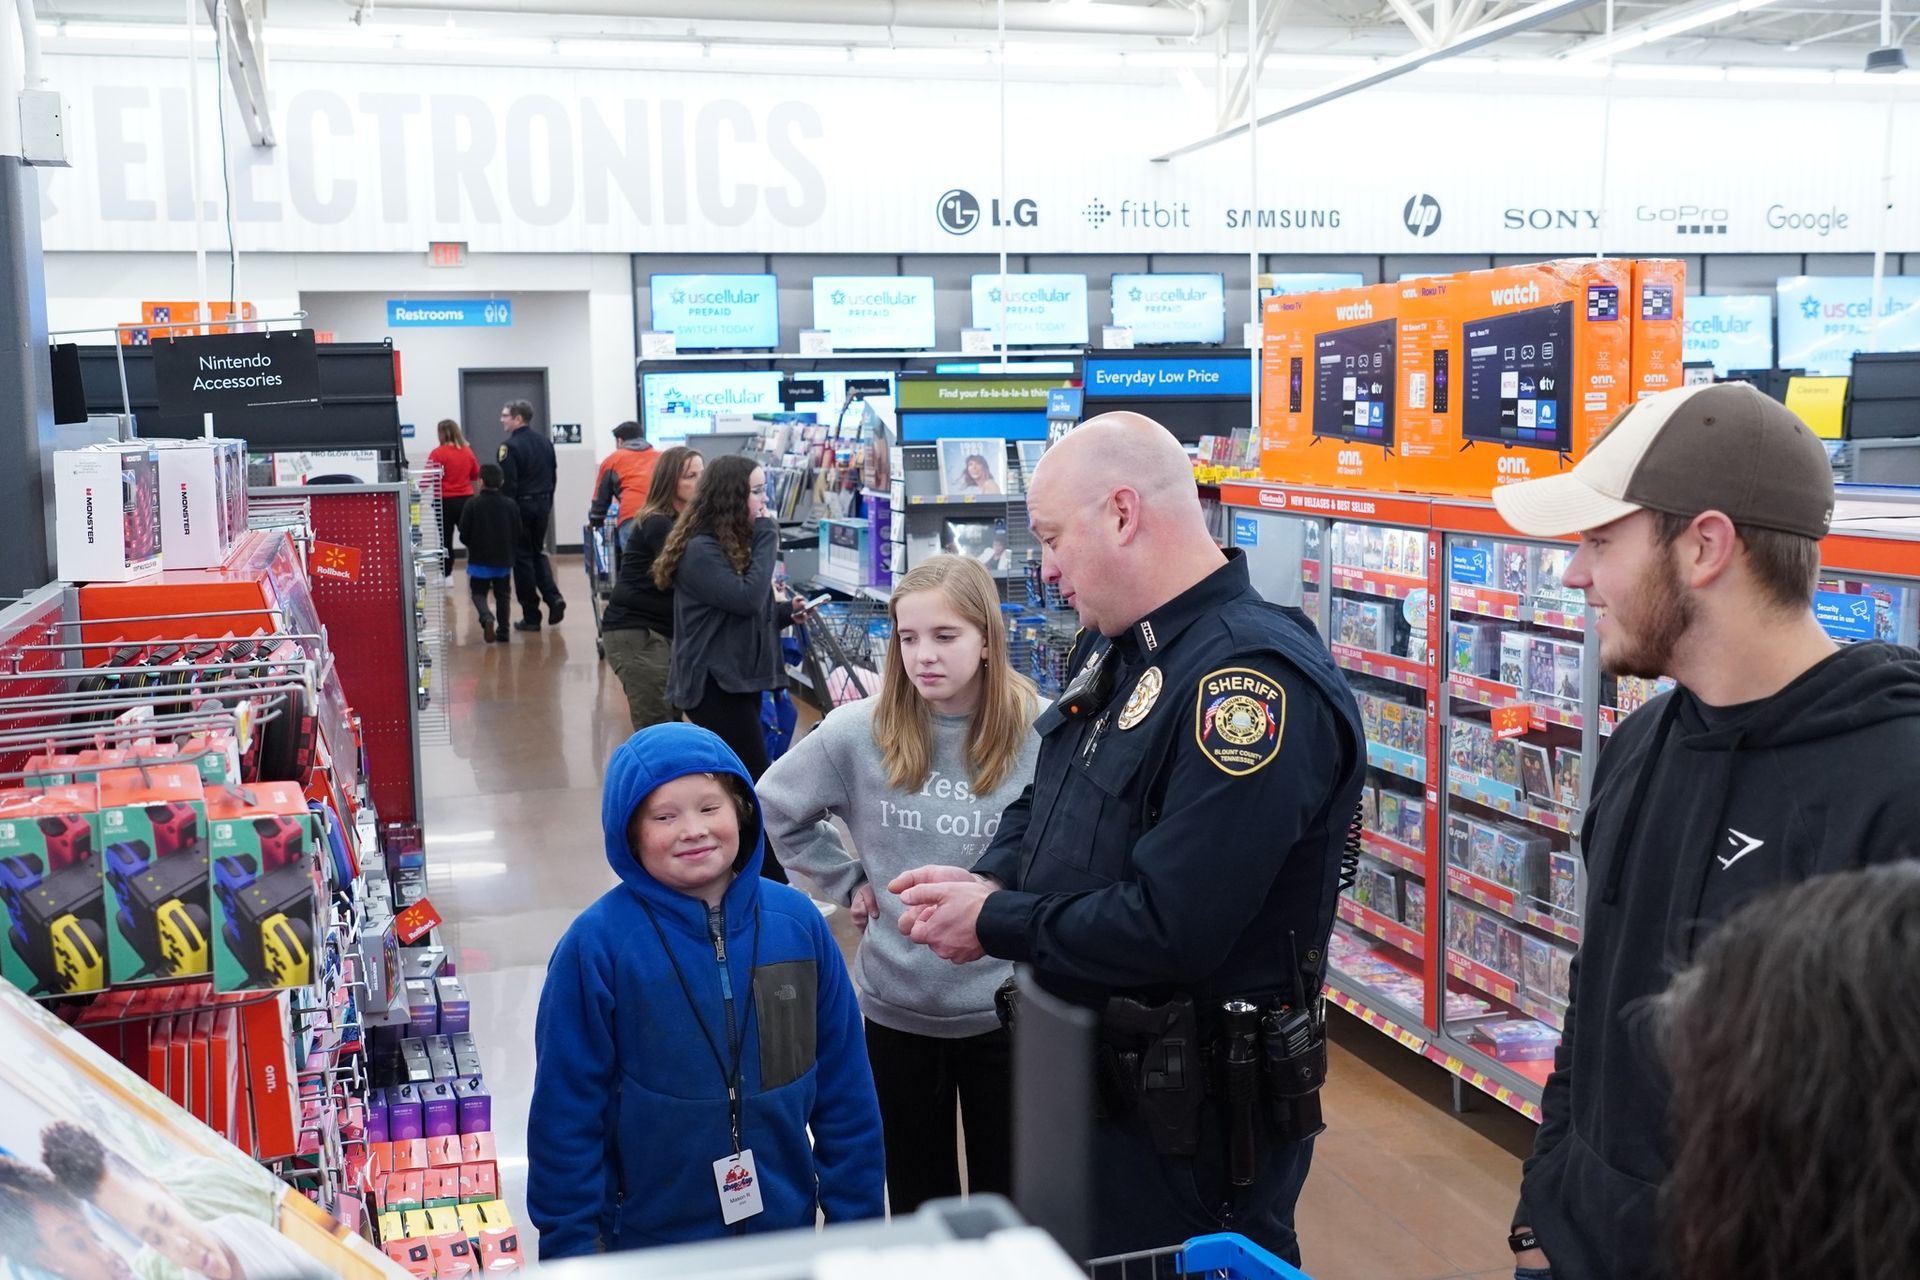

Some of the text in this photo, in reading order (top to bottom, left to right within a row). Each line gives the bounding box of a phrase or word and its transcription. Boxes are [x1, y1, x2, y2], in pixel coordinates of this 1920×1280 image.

[1120, 199, 1191, 228] fitbit
[1226, 208, 1342, 229] SAMSUNG
[1504, 207, 1603, 230] SONY
[1636, 205, 1729, 223] GoPro
[1766, 204, 1849, 237] Google
[688, 289, 761, 305] uscellular
[848, 291, 918, 306] uscellular
[1004, 288, 1071, 303] uscellular
[1144, 288, 1208, 303] uscellular
[1490, 280, 1540, 307] watch
[395, 307, 465, 322] Restrooms
[688, 308, 732, 316] PREPAID
[1336, 299, 1373, 321] watch
[1823, 297, 1914, 318] uscelular
[1683, 315, 1753, 334] scellular
[198, 352, 272, 372] Nintendo
[192, 371, 283, 392] Accessories
[1096, 368, 1220, 388] Everyday Low Price
[1591, 374, 1616, 385] onn.
[1644, 373, 1669, 384] onn.
[939, 388, 959, 398] Find
[960, 389, 979, 400] your
[1031, 387, 1050, 399] thin
[1337, 450, 1363, 466] onn.
[1497, 455, 1531, 475] onn.
[1261, 493, 1285, 506] Nintendo
[1290, 495, 1304, 507] NEW
[1304, 496, 1330, 510] RELEASES
[1336, 498, 1350, 512] BEST
[1350, 500, 1376, 514] SELLERS
[83, 496, 95, 545] MONSTER
[180, 491, 190, 536] MONSTER
[316, 565, 352, 579] Rollback
[1450, 586, 1476, 599] RELEASE
[1816, 602, 1840, 614] Security
[1816, 612, 1839, 622] cameras
[1207, 675, 1279, 702] SHERIFF
[1219, 696, 1265, 718] BLOUNT COUNTY
[1497, 725, 1523, 738] Rollback
[1214, 748, 1263, 761] BLOUNT COUNTY
[1220, 755, 1255, 766] TENNESSEE
[919, 770, 978, 804] Yes,
[879, 800, 1003, 838] I'm cold
[408, 918, 437, 940] Rollback
[264, 1064, 277, 1094] onn.
